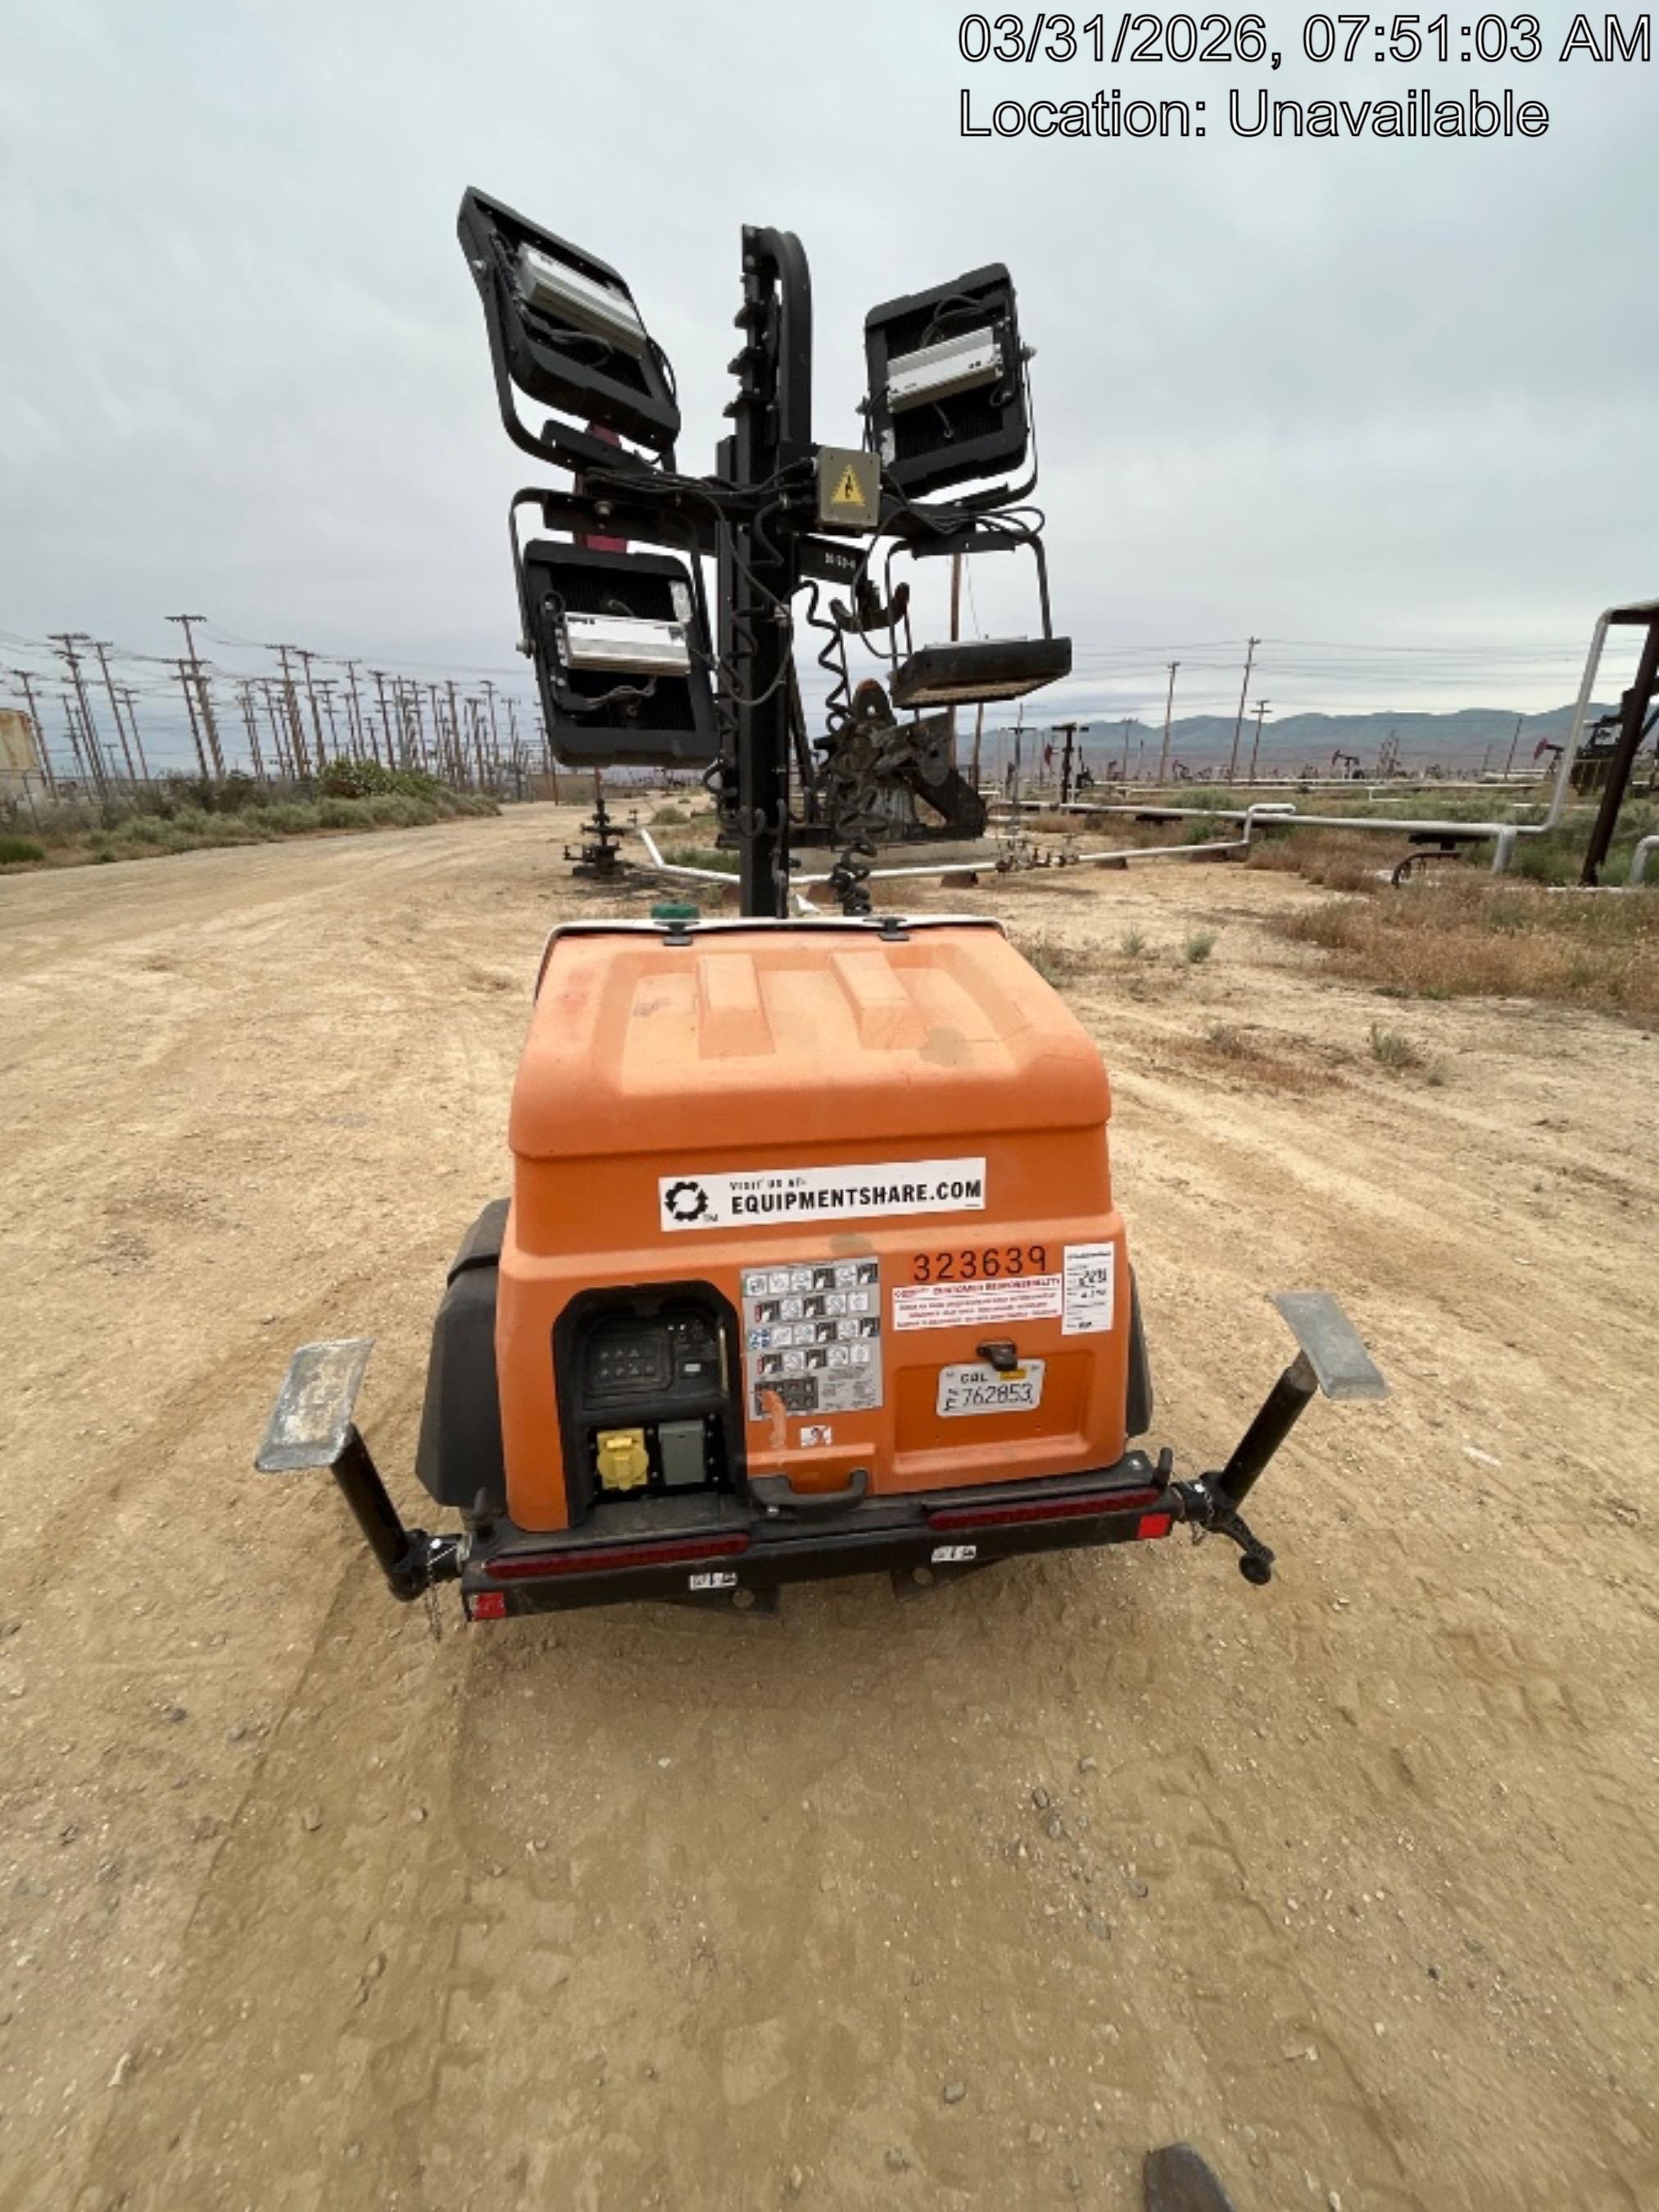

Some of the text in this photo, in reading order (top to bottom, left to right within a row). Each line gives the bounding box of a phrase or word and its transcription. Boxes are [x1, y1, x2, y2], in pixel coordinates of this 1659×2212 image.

[731, 1180, 981, 1215] EQUIPMENTSHARE.COM
[913, 1245, 1046, 1282] 323639
[960, 1372, 990, 1384] CAL
[962, 1383, 1034, 1407] 762853
